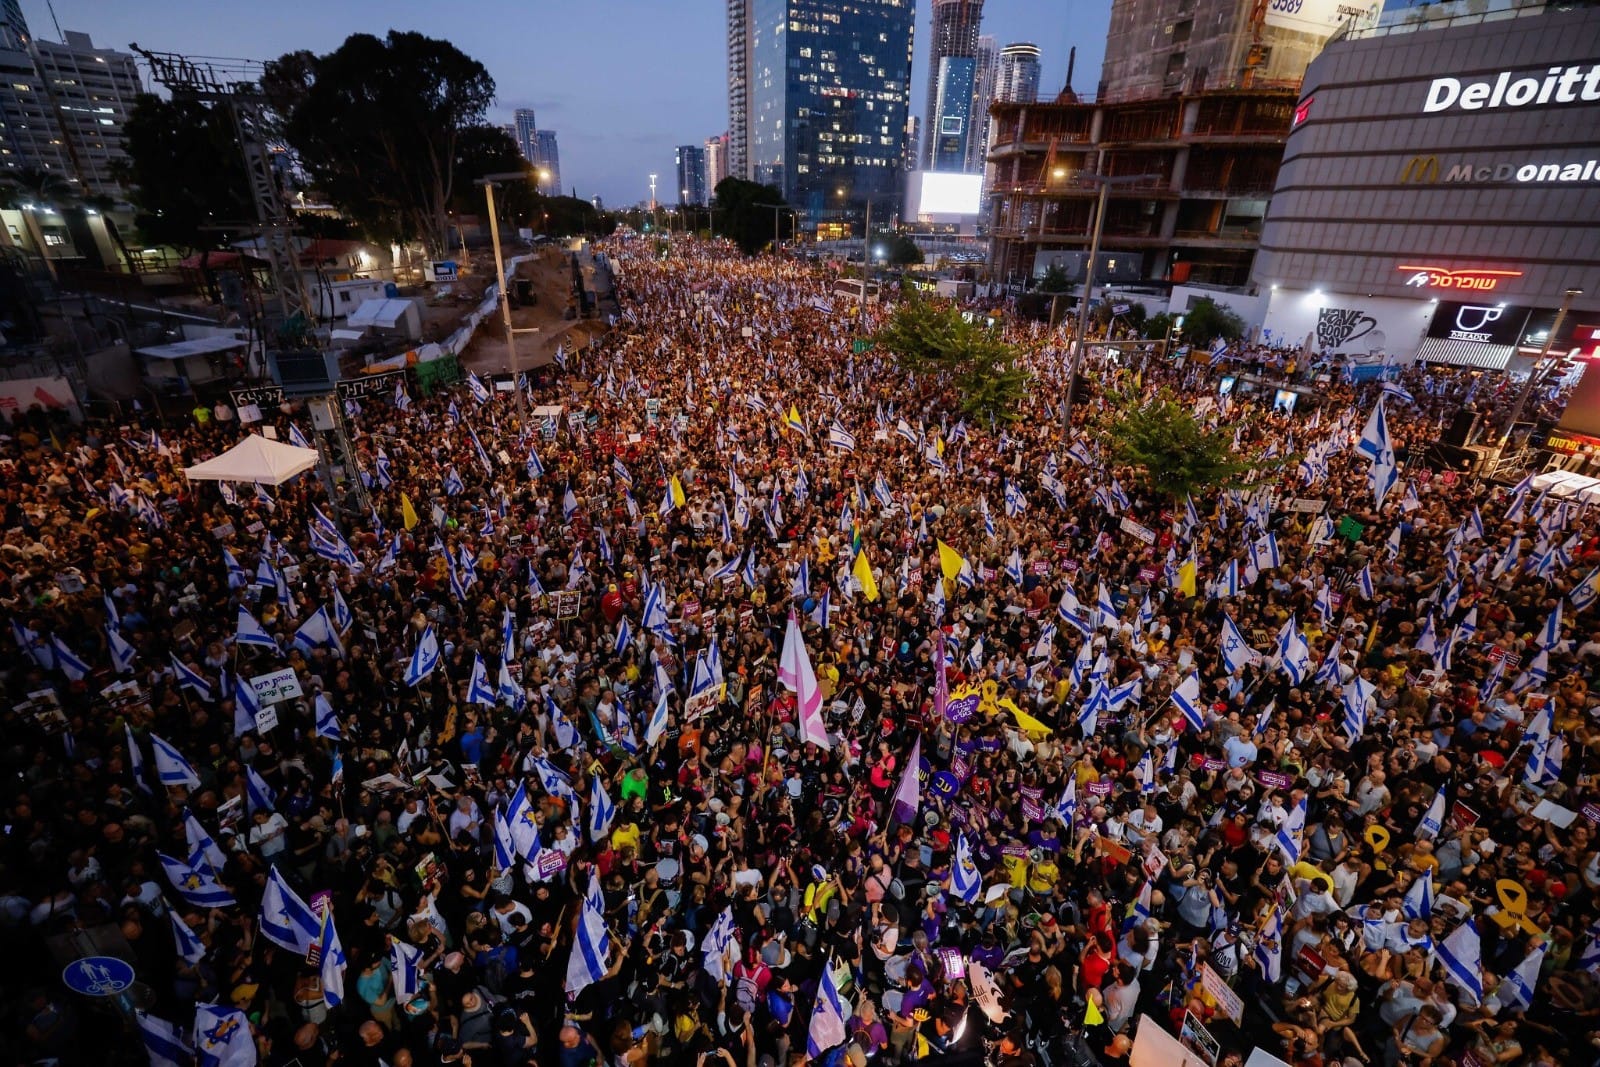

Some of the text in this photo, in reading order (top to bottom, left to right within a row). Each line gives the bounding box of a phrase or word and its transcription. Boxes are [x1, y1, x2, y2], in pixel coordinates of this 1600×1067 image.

[1430, 273, 1497, 290] שופרסל
[1317, 321, 1354, 338] GOOD
[1507, 911, 1523, 920] NOW
